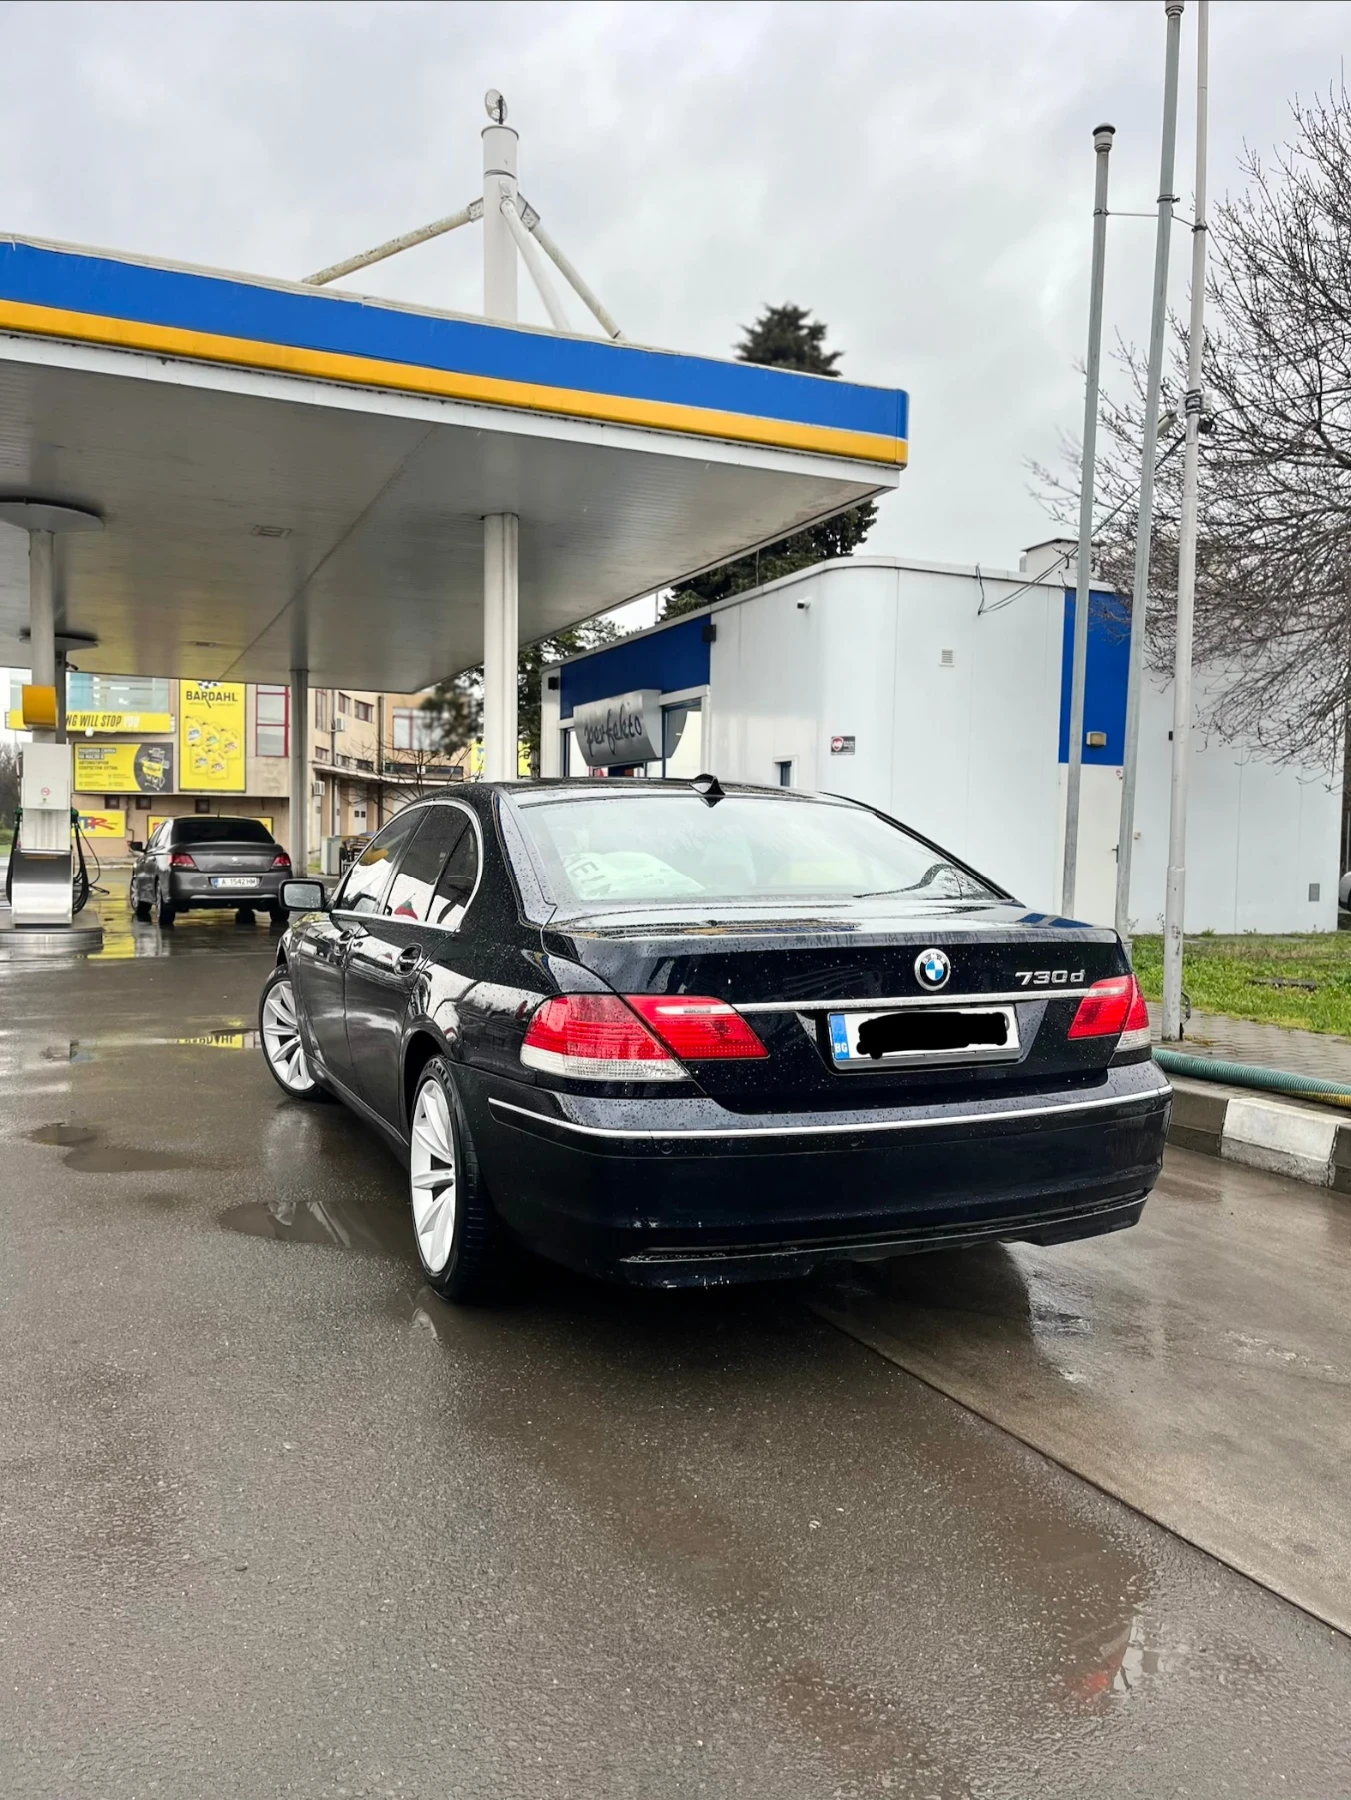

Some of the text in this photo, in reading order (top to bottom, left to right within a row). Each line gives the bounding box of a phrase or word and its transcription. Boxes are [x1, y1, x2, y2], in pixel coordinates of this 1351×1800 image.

[186, 690, 239, 703] BARDAHL
[80, 714, 99, 727] WILL
[101, 715, 122, 728] STOP
[584, 701, 643, 758] perfekto
[1015, 969, 1086, 986] 730d
[834, 1042, 848, 1053] BG
